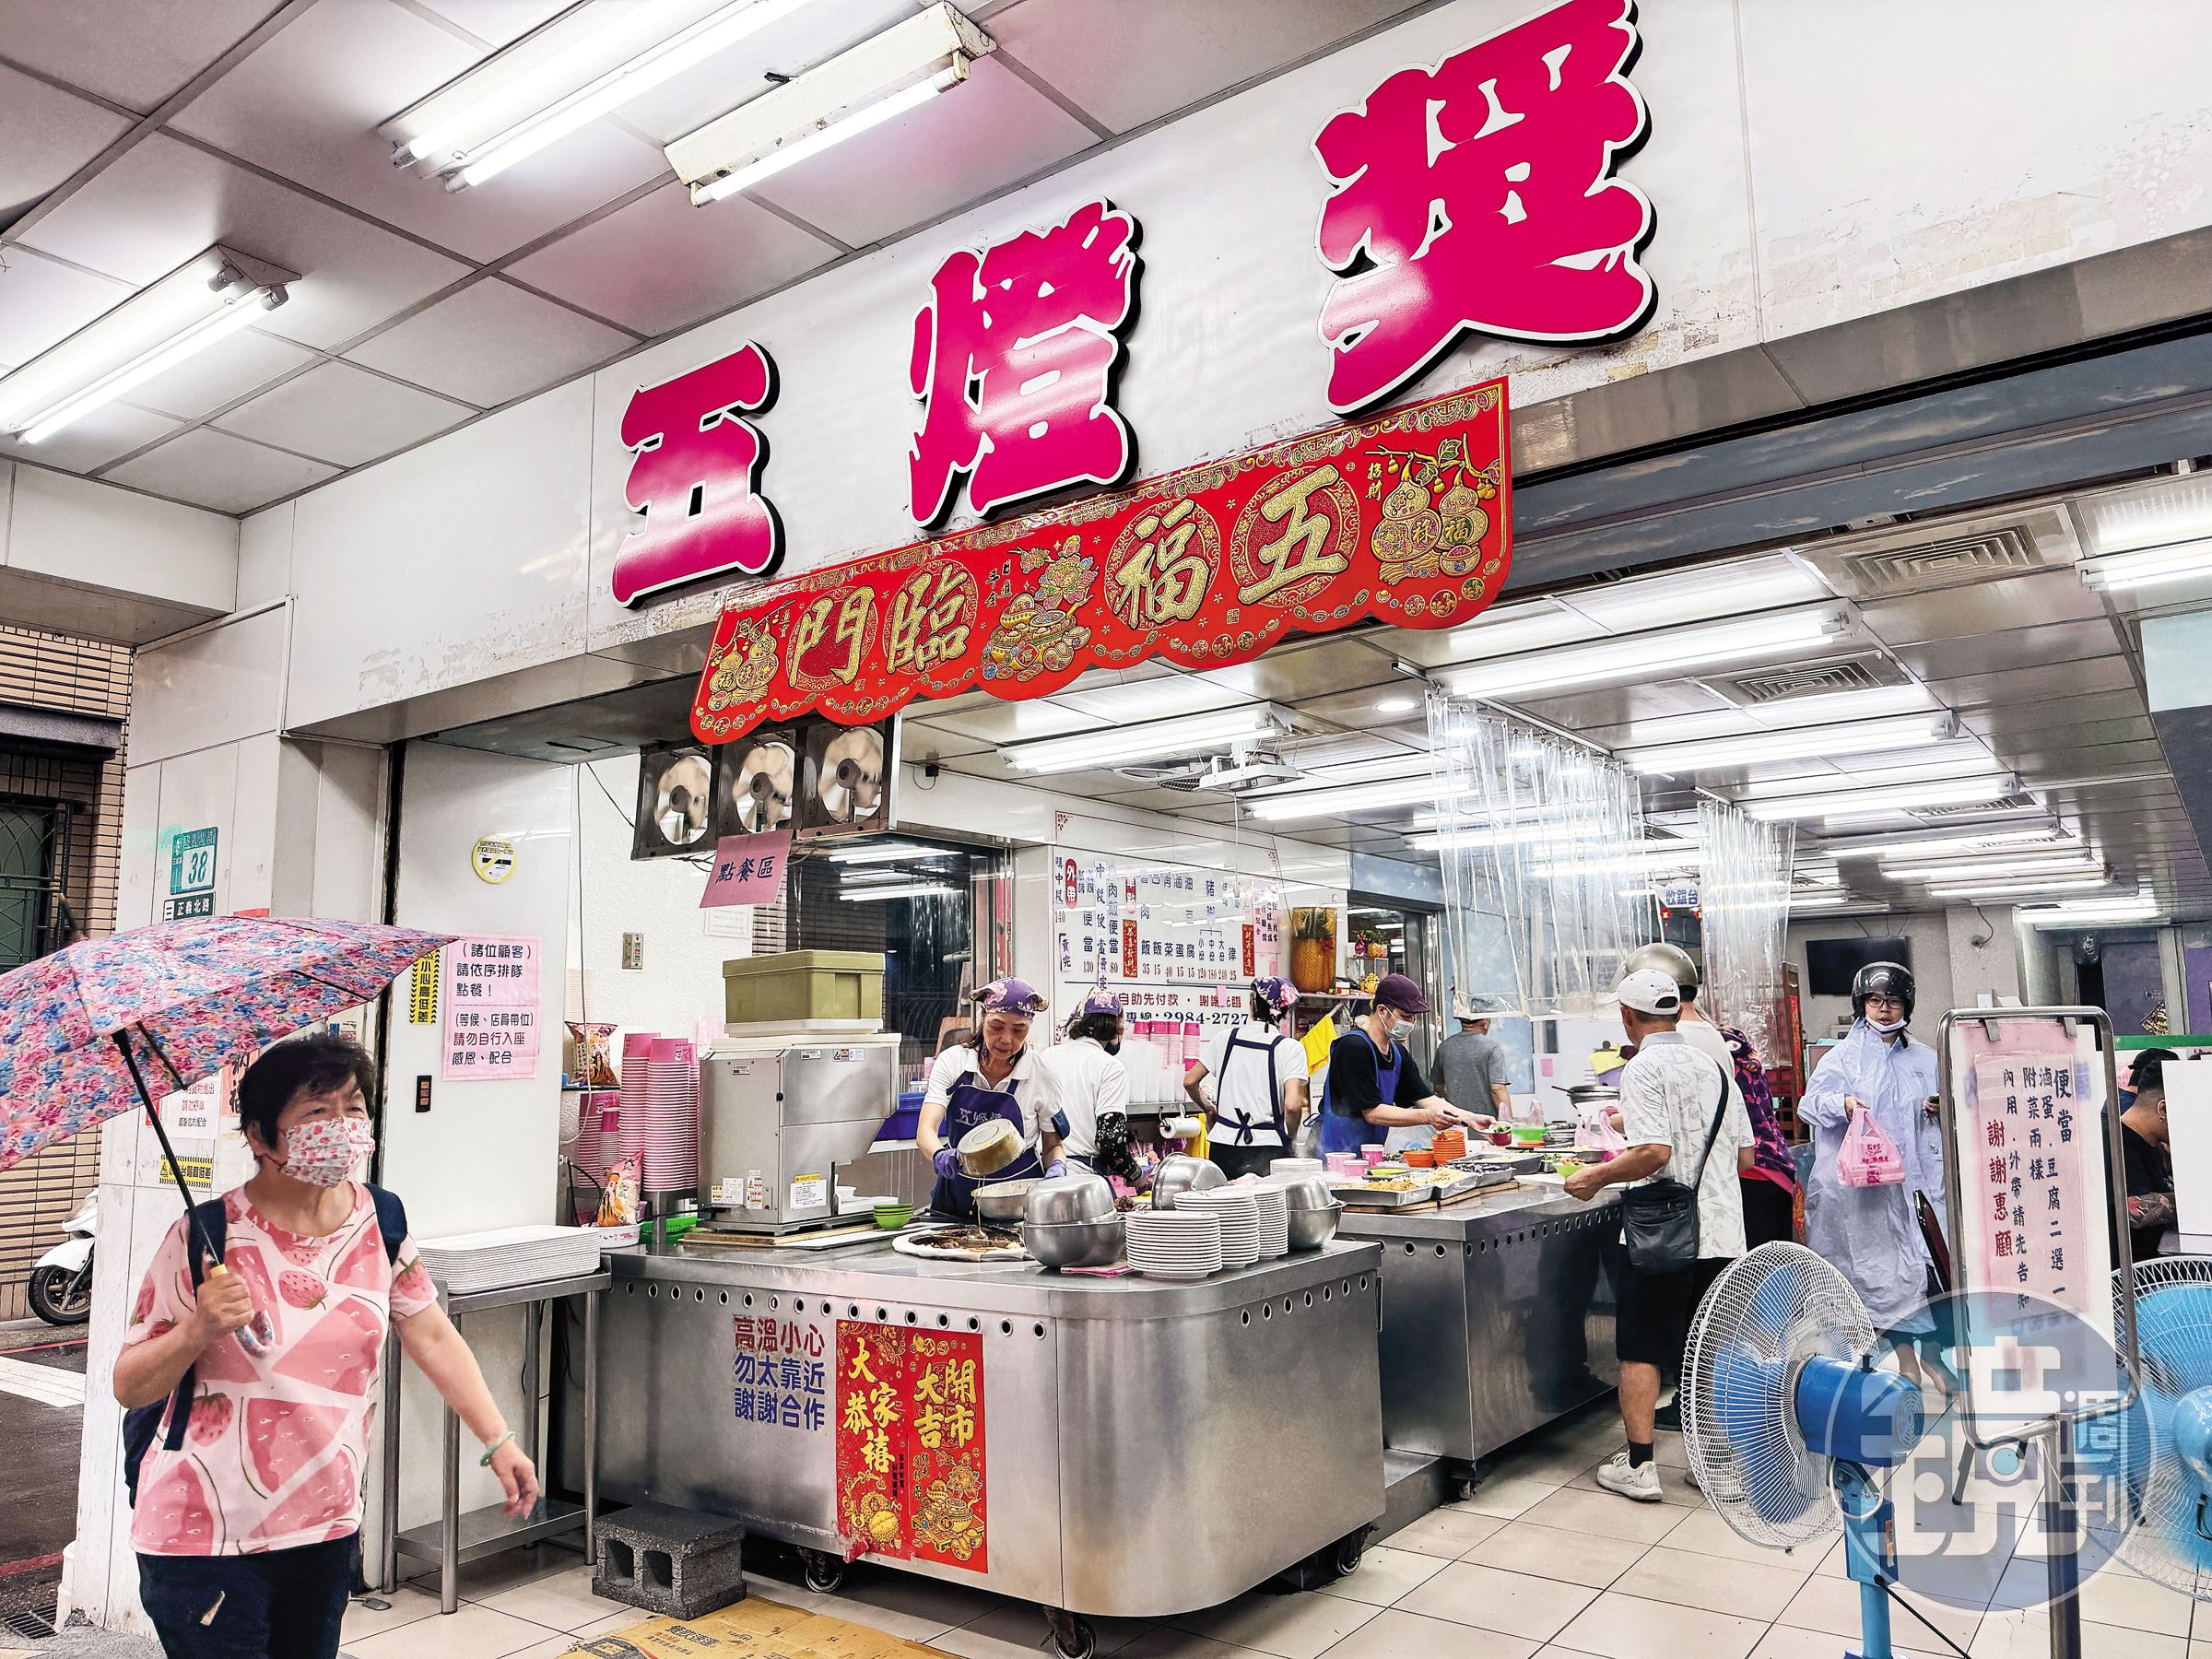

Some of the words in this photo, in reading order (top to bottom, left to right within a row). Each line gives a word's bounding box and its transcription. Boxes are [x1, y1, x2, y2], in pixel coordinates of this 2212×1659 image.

[1366, 463, 1382, 502] 招財
[1445, 519, 1469, 543] 福
[188, 851, 208, 884] 38
[715, 855, 775, 883] 點餐區
[1066, 865, 1077, 903] 外帶
[177, 898, 210, 916] 正義北路
[456, 962, 524, 978] 請依序排隊
[1083, 961, 1094, 973] 130
[1110, 961, 1118, 973] 80
[1143, 963, 1150, 975] 35
[1154, 964, 1161, 976] 15
[1177, 966, 1184, 978] 15
[1188, 967, 1195, 978] 15
[418, 960, 432, 1023] 小心高低差
[456, 982, 492, 997] 點餐！
[453, 1032, 525, 1046] 請勿自行入座
[452, 1051, 512, 1065] 感恩、配合
[2053, 1068, 2073, 1144] 便當
[1987, 1121, 2014, 1258] 謝謝惠顧
[733, 1315, 826, 1357] 高溫小心
[734, 1353, 826, 1395] 勿太靠近
[734, 1387, 826, 1431] 謝謝合作
